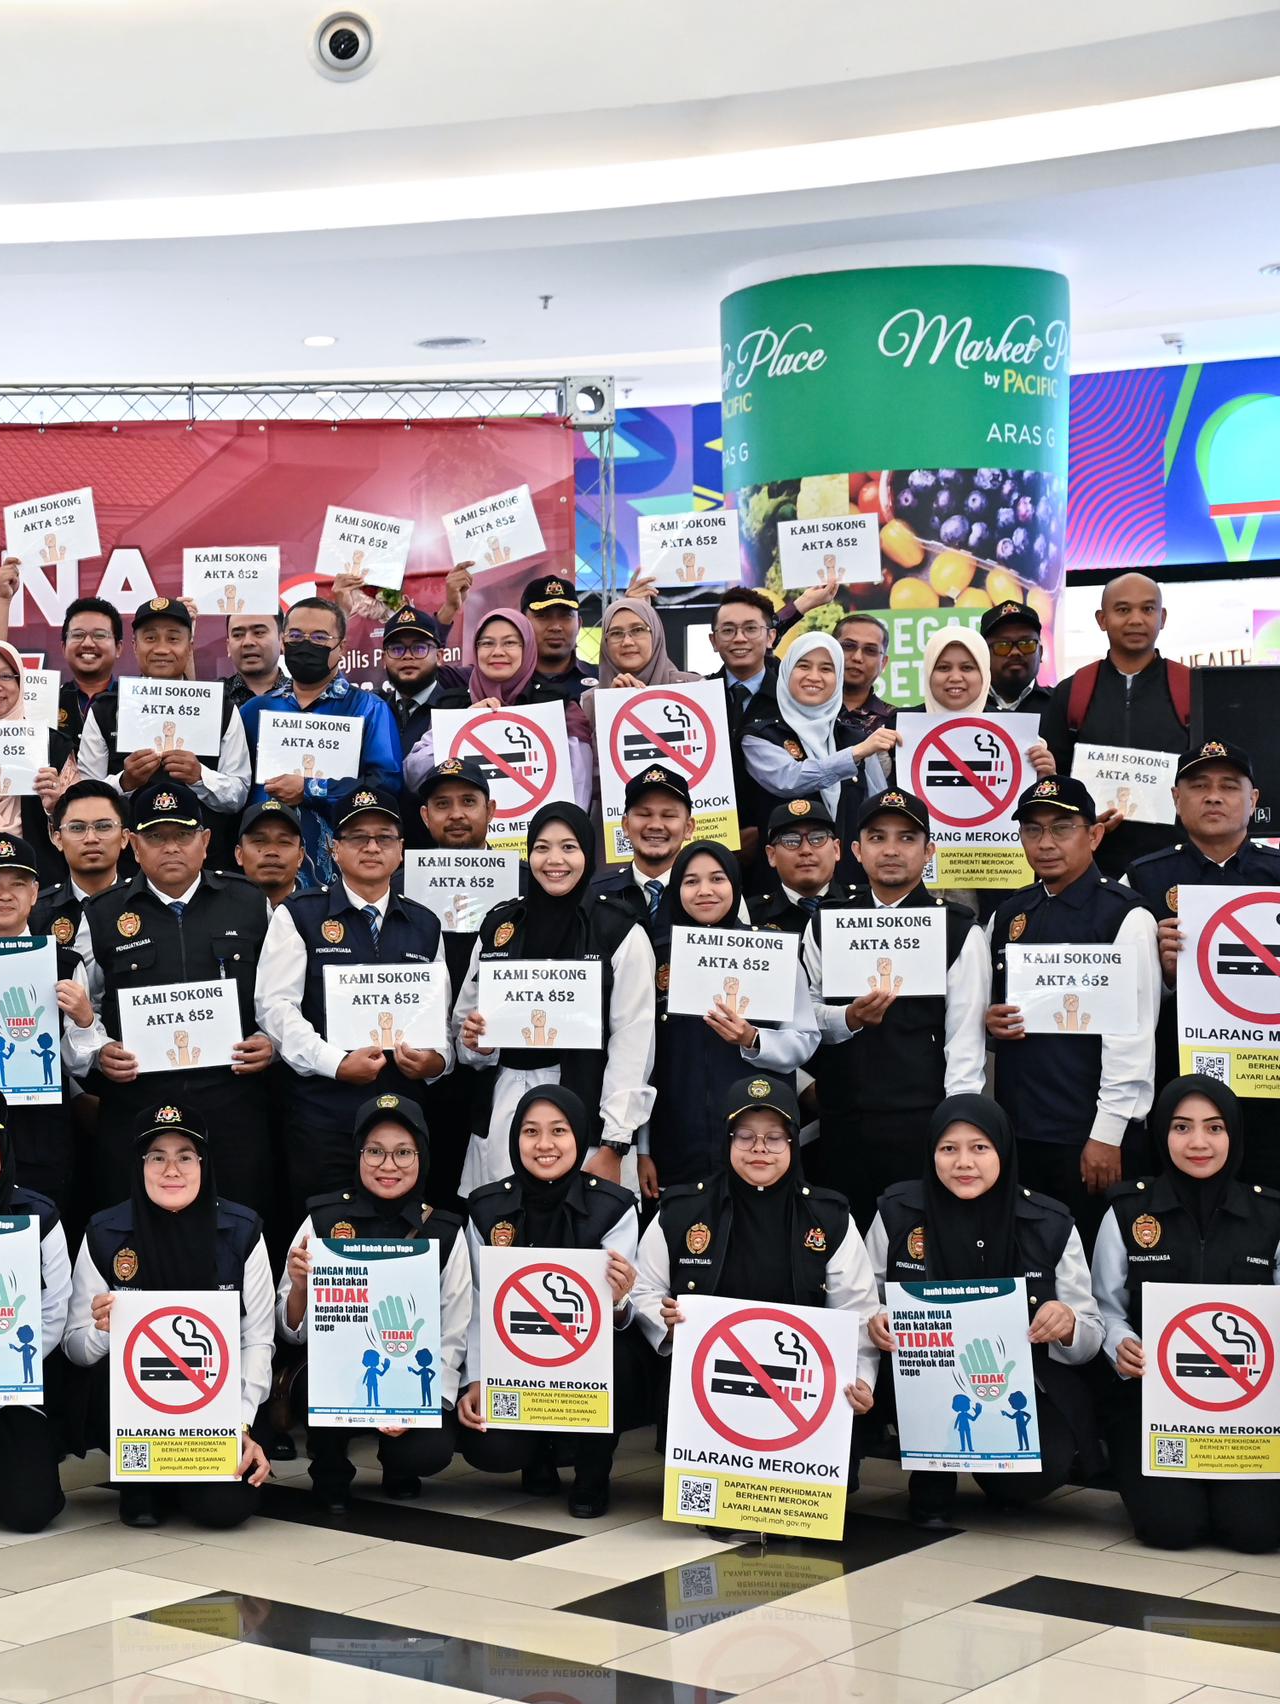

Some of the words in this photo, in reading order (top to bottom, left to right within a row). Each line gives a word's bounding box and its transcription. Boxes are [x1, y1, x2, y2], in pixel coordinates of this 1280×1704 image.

[877, 308, 1041, 370] Market
[735, 322, 828, 389] Place
[984, 370, 1001, 388] by
[1004, 369, 1058, 399] PACIFIC
[986, 423, 1042, 446] ARAS
[1046, 427, 1056, 447] G
[790, 524, 818, 535] KAMI
[822, 520, 865, 531] SOKONG
[802, 540, 832, 551] AKTA
[836, 538, 857, 547] 852
[195, 554, 222, 562] KAMI
[225, 553, 266, 561] SOKONG
[204, 570, 234, 578] AKTA
[238, 569, 258, 578] 852
[337, 649, 370, 674] ajlis
[133, 686, 161, 695] KAMI
[165, 687, 210, 698] SOKONG
[141, 704, 174, 714] AKTA
[178, 705, 200, 716] 852
[418, 857, 450, 866] KAMI
[454, 857, 505, 867] SOKONG
[429, 877, 465, 887] AKTA
[470, 876, 494, 887] 852
[836, 917, 872, 928] KAMI
[876, 916, 931, 927] SOKONG
[849, 939, 889, 950] AKTA
[894, 937, 919, 949] 852
[1024, 953, 1059, 963] KAMI
[1064, 953, 1121, 964] SOKONG
[493, 969, 528, 979] KAMI
[532, 969, 586, 980] SOKONG
[1035, 975, 1076, 985] AKTA
[1081, 974, 1108, 986] 852
[132, 992, 166, 1006] KAMI
[170, 987, 222, 1001] SOKONG
[505, 991, 544, 1001] AKTA
[548, 990, 574, 1002] 852
[146, 1012, 184, 1026] AKTA
[188, 1009, 213, 1021] 852
[487, 1378, 545, 1388] DILARANG
[550, 1381, 607, 1390] MEROKOK
[117, 1428, 175, 1436] DILARANG
[179, 1428, 236, 1436] MEROKOK
[1150, 1423, 1214, 1433] DILARANG
[1219, 1426, 1280, 1434] MEROKOK
[673, 1448, 753, 1468] DILARANG
[759, 1458, 839, 1478] MEROKOK
[724, 1482, 767, 1496] DAPATKAN
[769, 1486, 831, 1498] PERKHIDMATAN
[736, 1492, 776, 1501] BERHENTI
[778, 1496, 819, 1506] MEROKOK
[722, 1502, 750, 1510] LAYARI
[752, 1506, 781, 1514] LAMAN
[783, 1509, 828, 1520] SESAWANG
